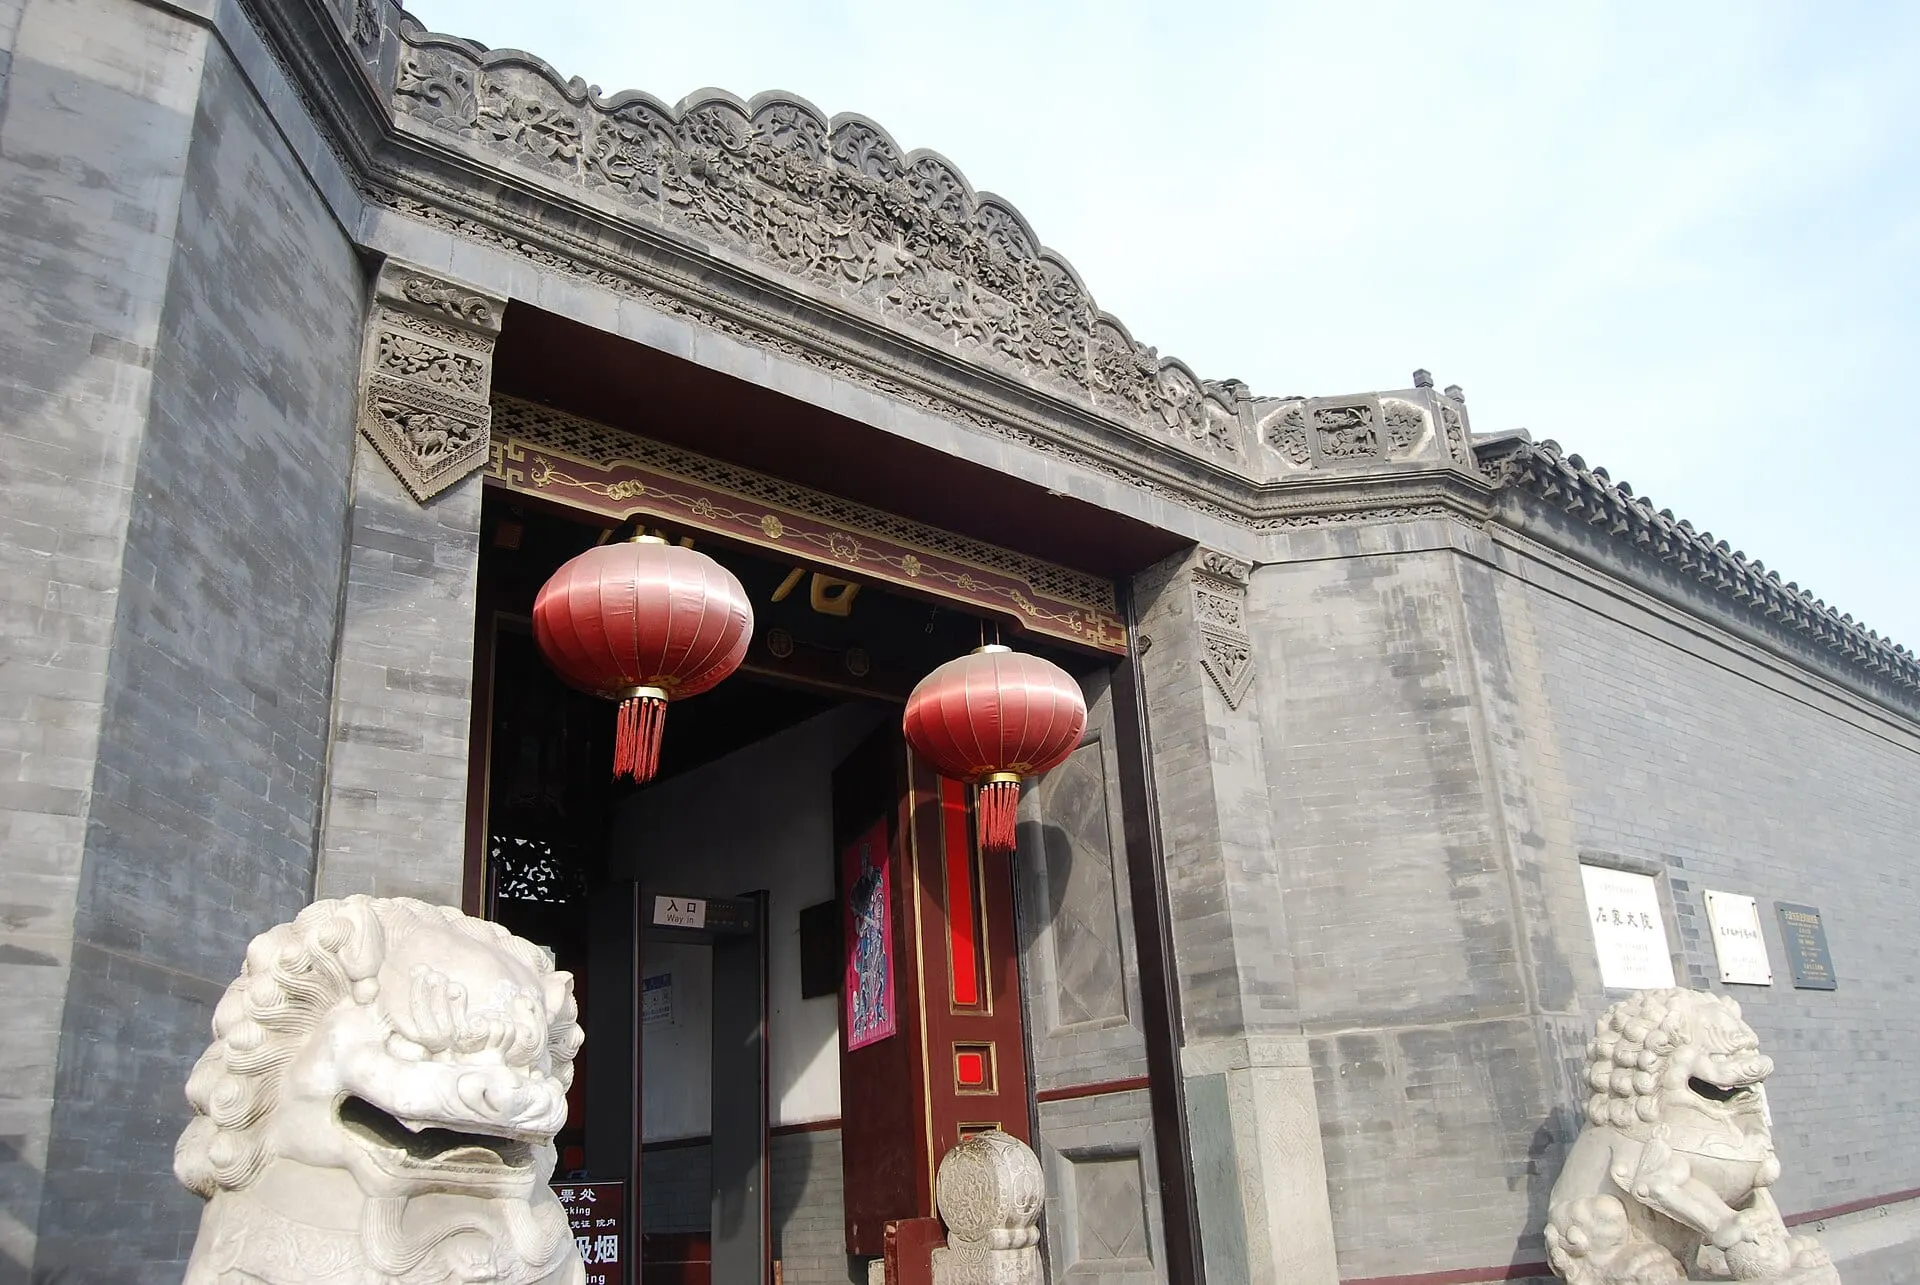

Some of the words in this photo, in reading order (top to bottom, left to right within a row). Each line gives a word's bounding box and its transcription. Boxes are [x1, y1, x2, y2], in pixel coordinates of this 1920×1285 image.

[667, 899, 696, 913] 入口
[666, 913, 684, 924] Way
[686, 916, 694, 924] in
